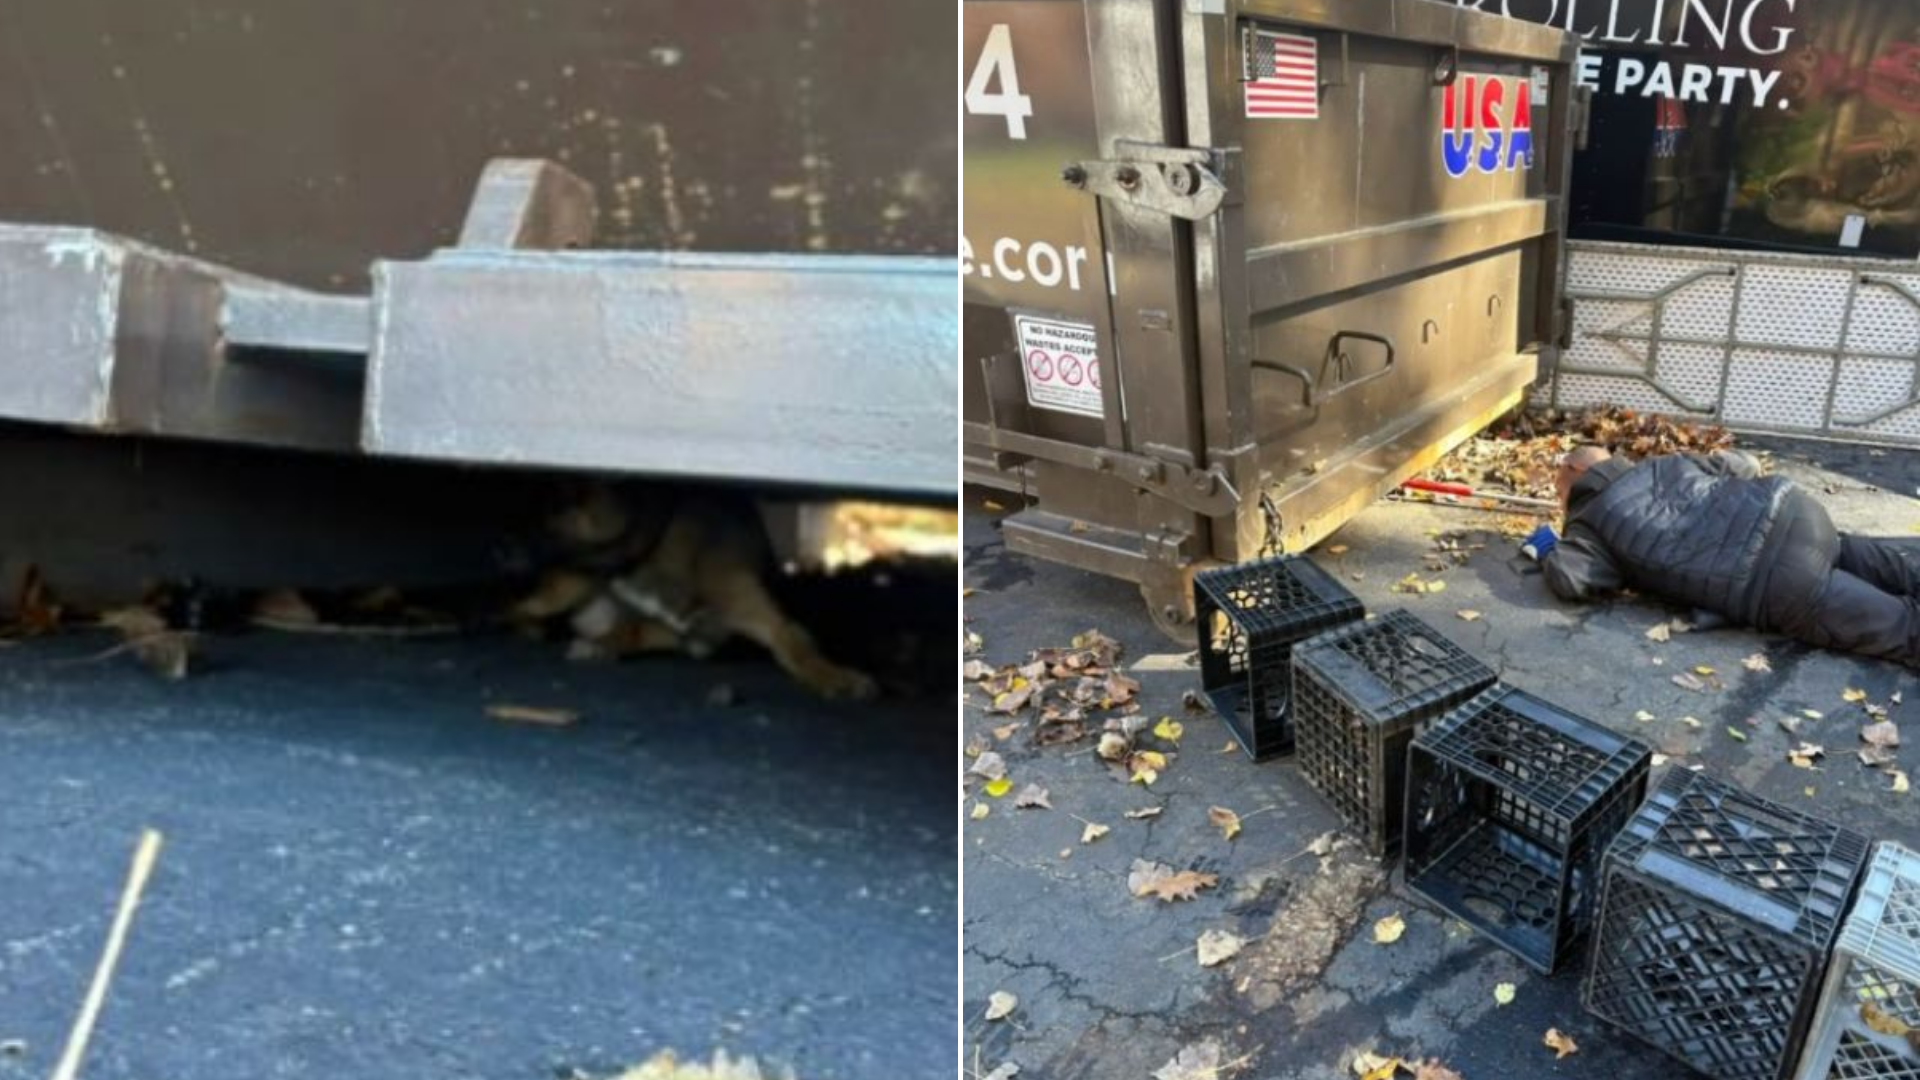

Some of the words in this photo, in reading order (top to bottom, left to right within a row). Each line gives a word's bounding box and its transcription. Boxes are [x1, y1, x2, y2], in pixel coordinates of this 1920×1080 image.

[1456, 0, 1796, 55] LLING
[964, 23, 1033, 140] 4
[1614, 58, 1789, 110] PARTY.
[1025, 339, 1061, 351] WASTES
[1029, 325, 1043, 335] NO
